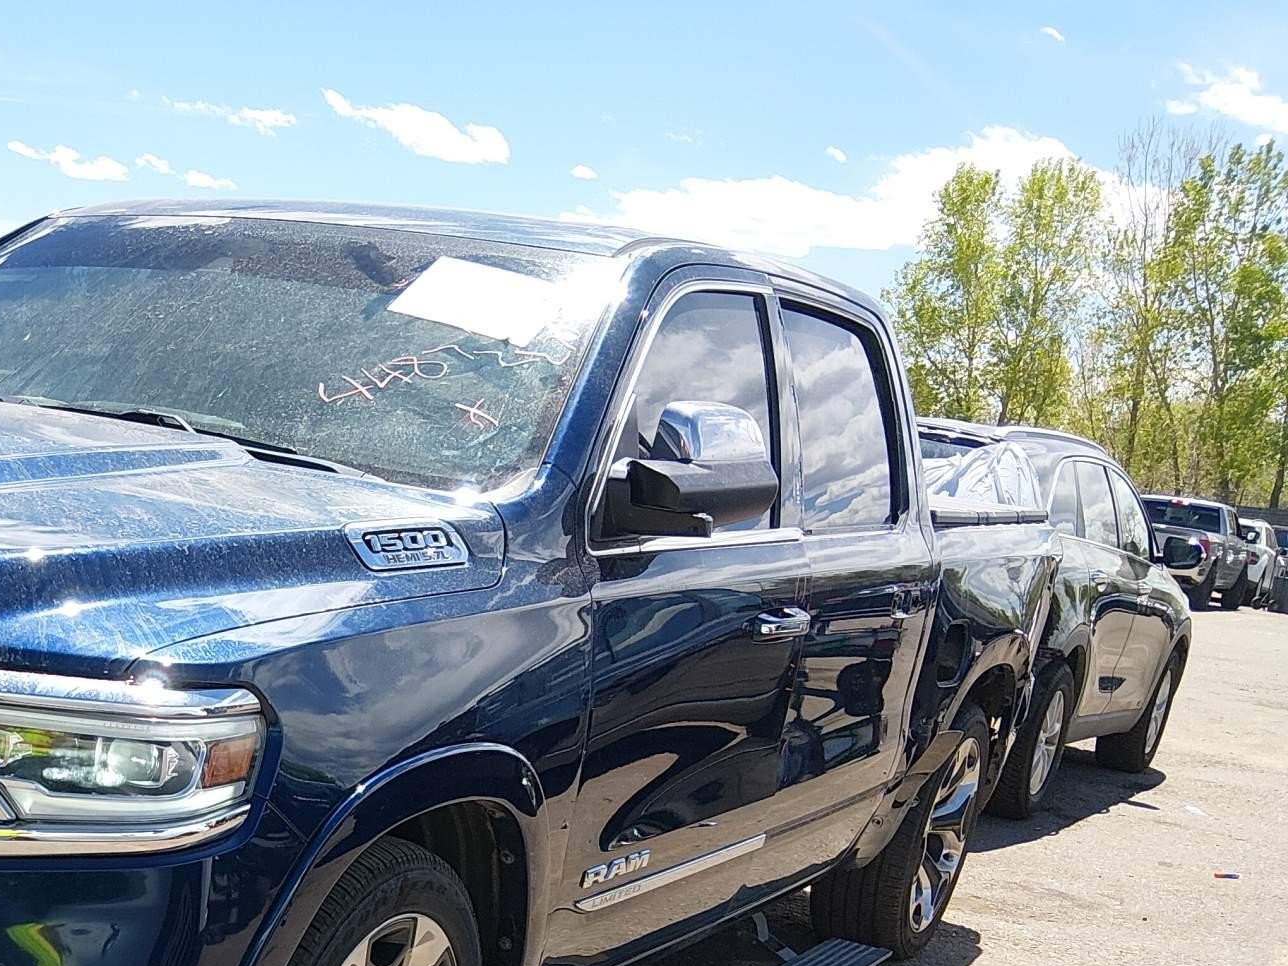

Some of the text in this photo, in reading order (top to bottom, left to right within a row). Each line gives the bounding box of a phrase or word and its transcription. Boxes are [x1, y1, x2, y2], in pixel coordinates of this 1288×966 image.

[365, 530, 448, 552] 1500
[384, 552, 421, 564] HEMI
[579, 849, 651, 889] RAM
[591, 885, 641, 908] LIMITED
